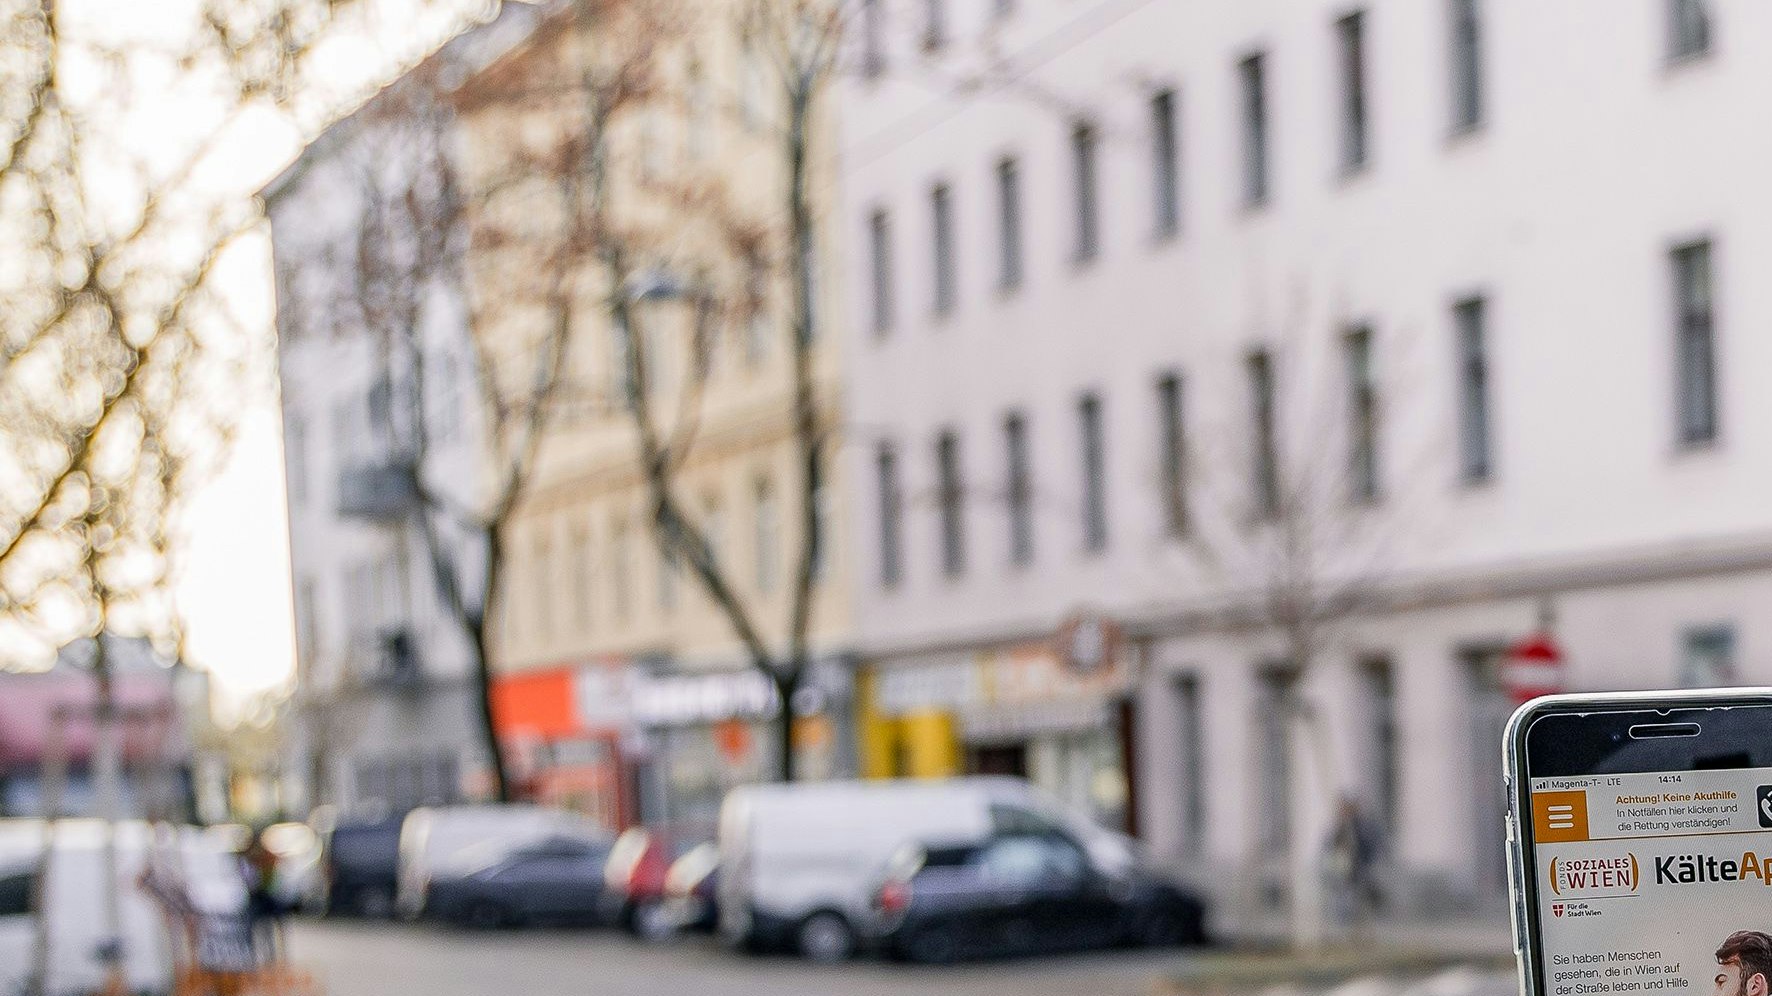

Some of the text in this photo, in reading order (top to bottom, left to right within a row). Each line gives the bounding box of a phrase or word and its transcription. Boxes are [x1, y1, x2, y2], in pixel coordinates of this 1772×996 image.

[1607, 778, 1621, 786] LTE
[1658, 775, 1681, 784] 14:14
[1616, 791, 1737, 805] Achtung! Keine Akuthilfe
[1617, 804, 1738, 817] In Notfällen hier klicken und
[1618, 818, 1731, 831] die Rettung verständigen!
[1566, 858, 1629, 871] SOZIALES
[1567, 870, 1631, 889] WIEN
[1553, 950, 1661, 965] Sie haben Menschen
[1555, 963, 1680, 982] gesehen, die in Wien auf
[1556, 978, 1688, 995] der Straße leben und Hilfe
